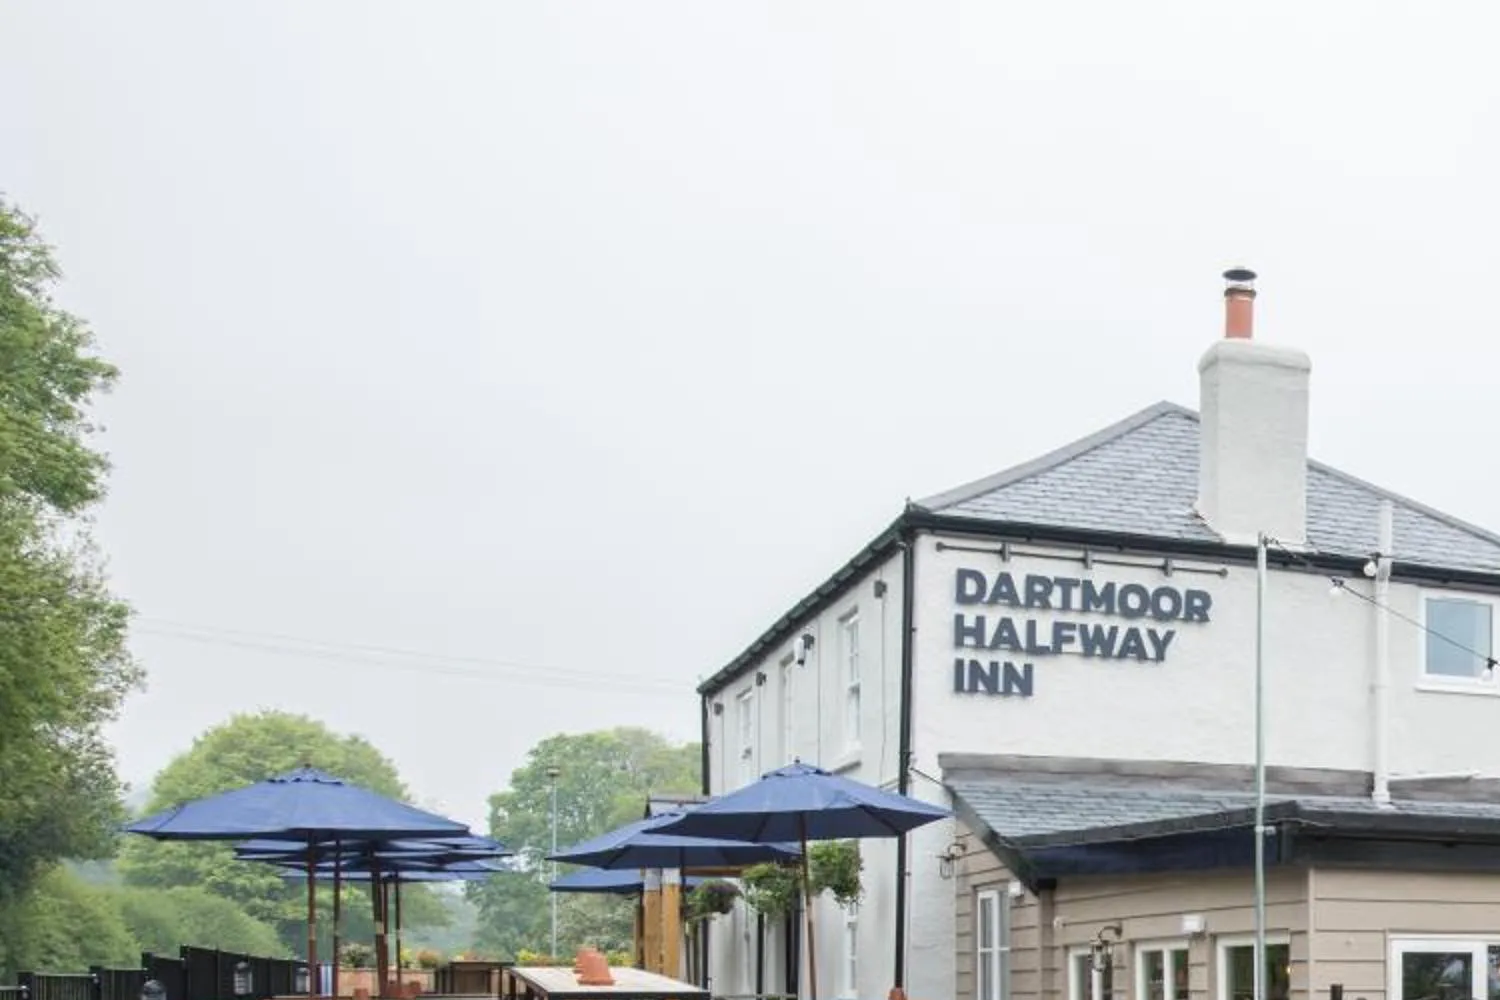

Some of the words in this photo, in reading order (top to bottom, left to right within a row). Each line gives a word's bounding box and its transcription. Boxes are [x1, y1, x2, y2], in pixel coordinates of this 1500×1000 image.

[955, 567, 1213, 622] DARTMOOR
[953, 613, 1176, 662] HALFWAY
[953, 658, 1034, 697] INN
